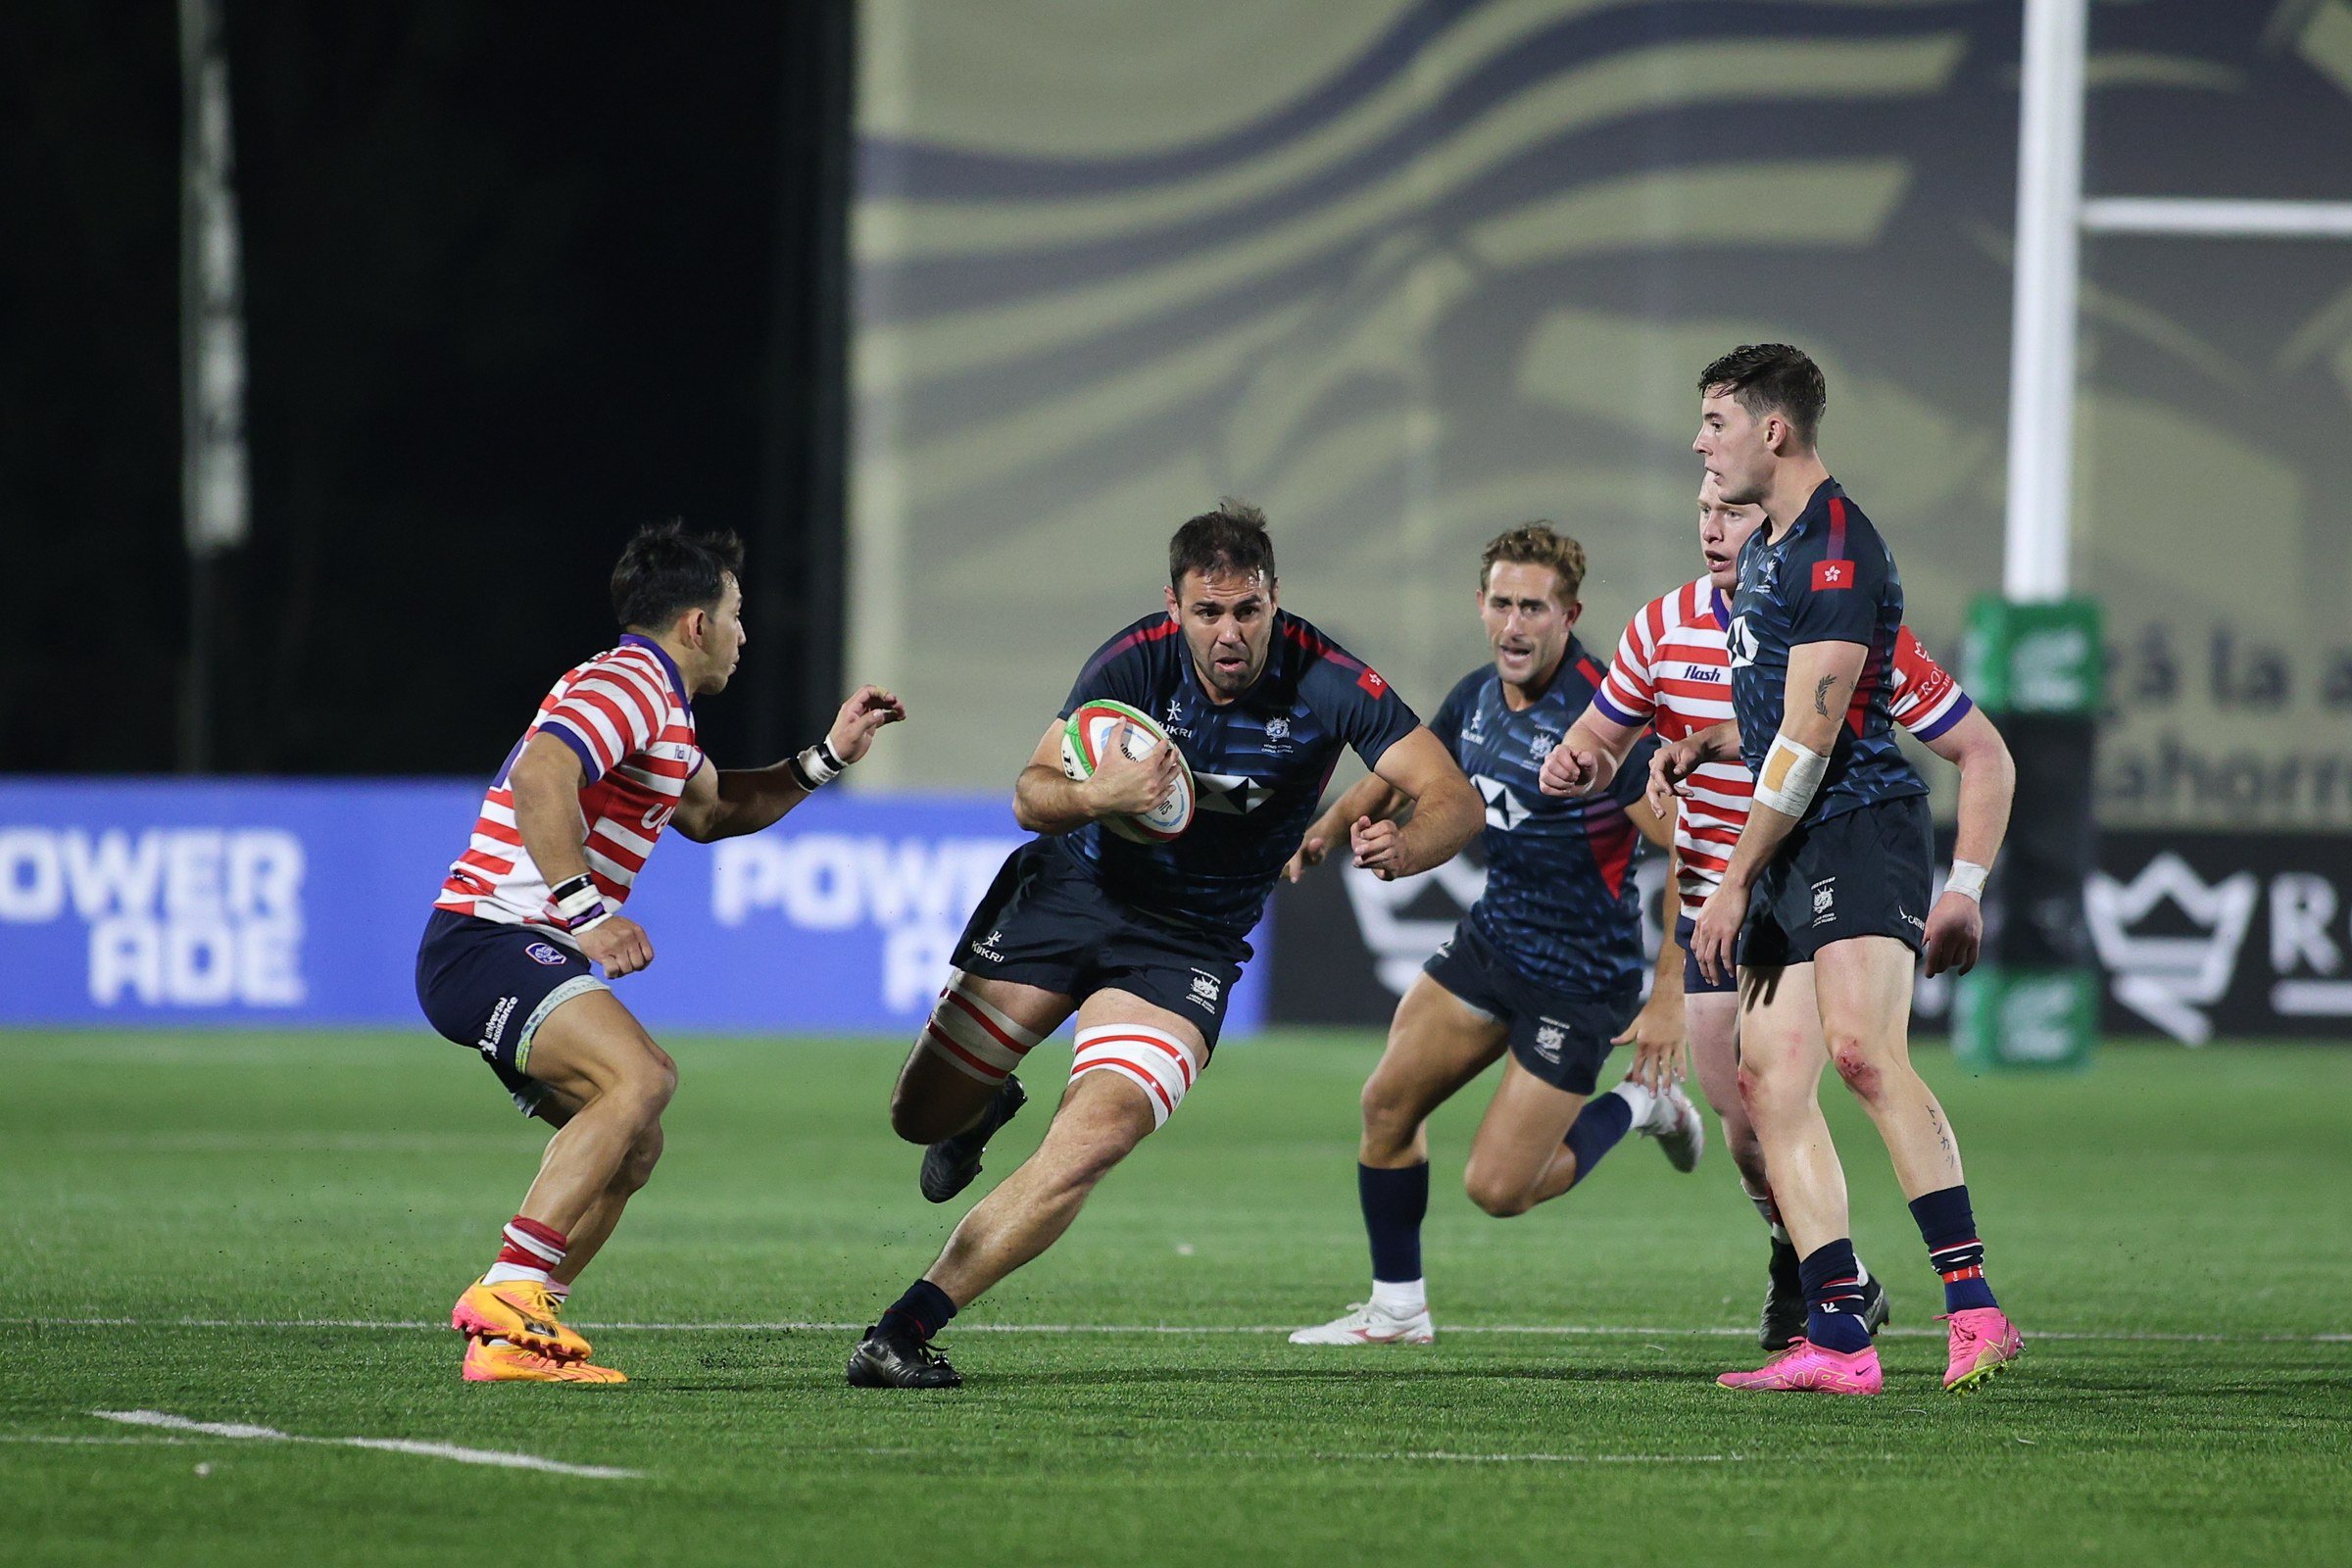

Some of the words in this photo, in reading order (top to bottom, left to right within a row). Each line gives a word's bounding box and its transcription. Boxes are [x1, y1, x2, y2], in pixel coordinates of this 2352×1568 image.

[1683, 664, 1721, 682] flash
[90, 919, 306, 1007] ADE
[971, 940, 1004, 963] KUKRI
[484, 997, 508, 1039] universal
[493, 996, 518, 1045] assistance
